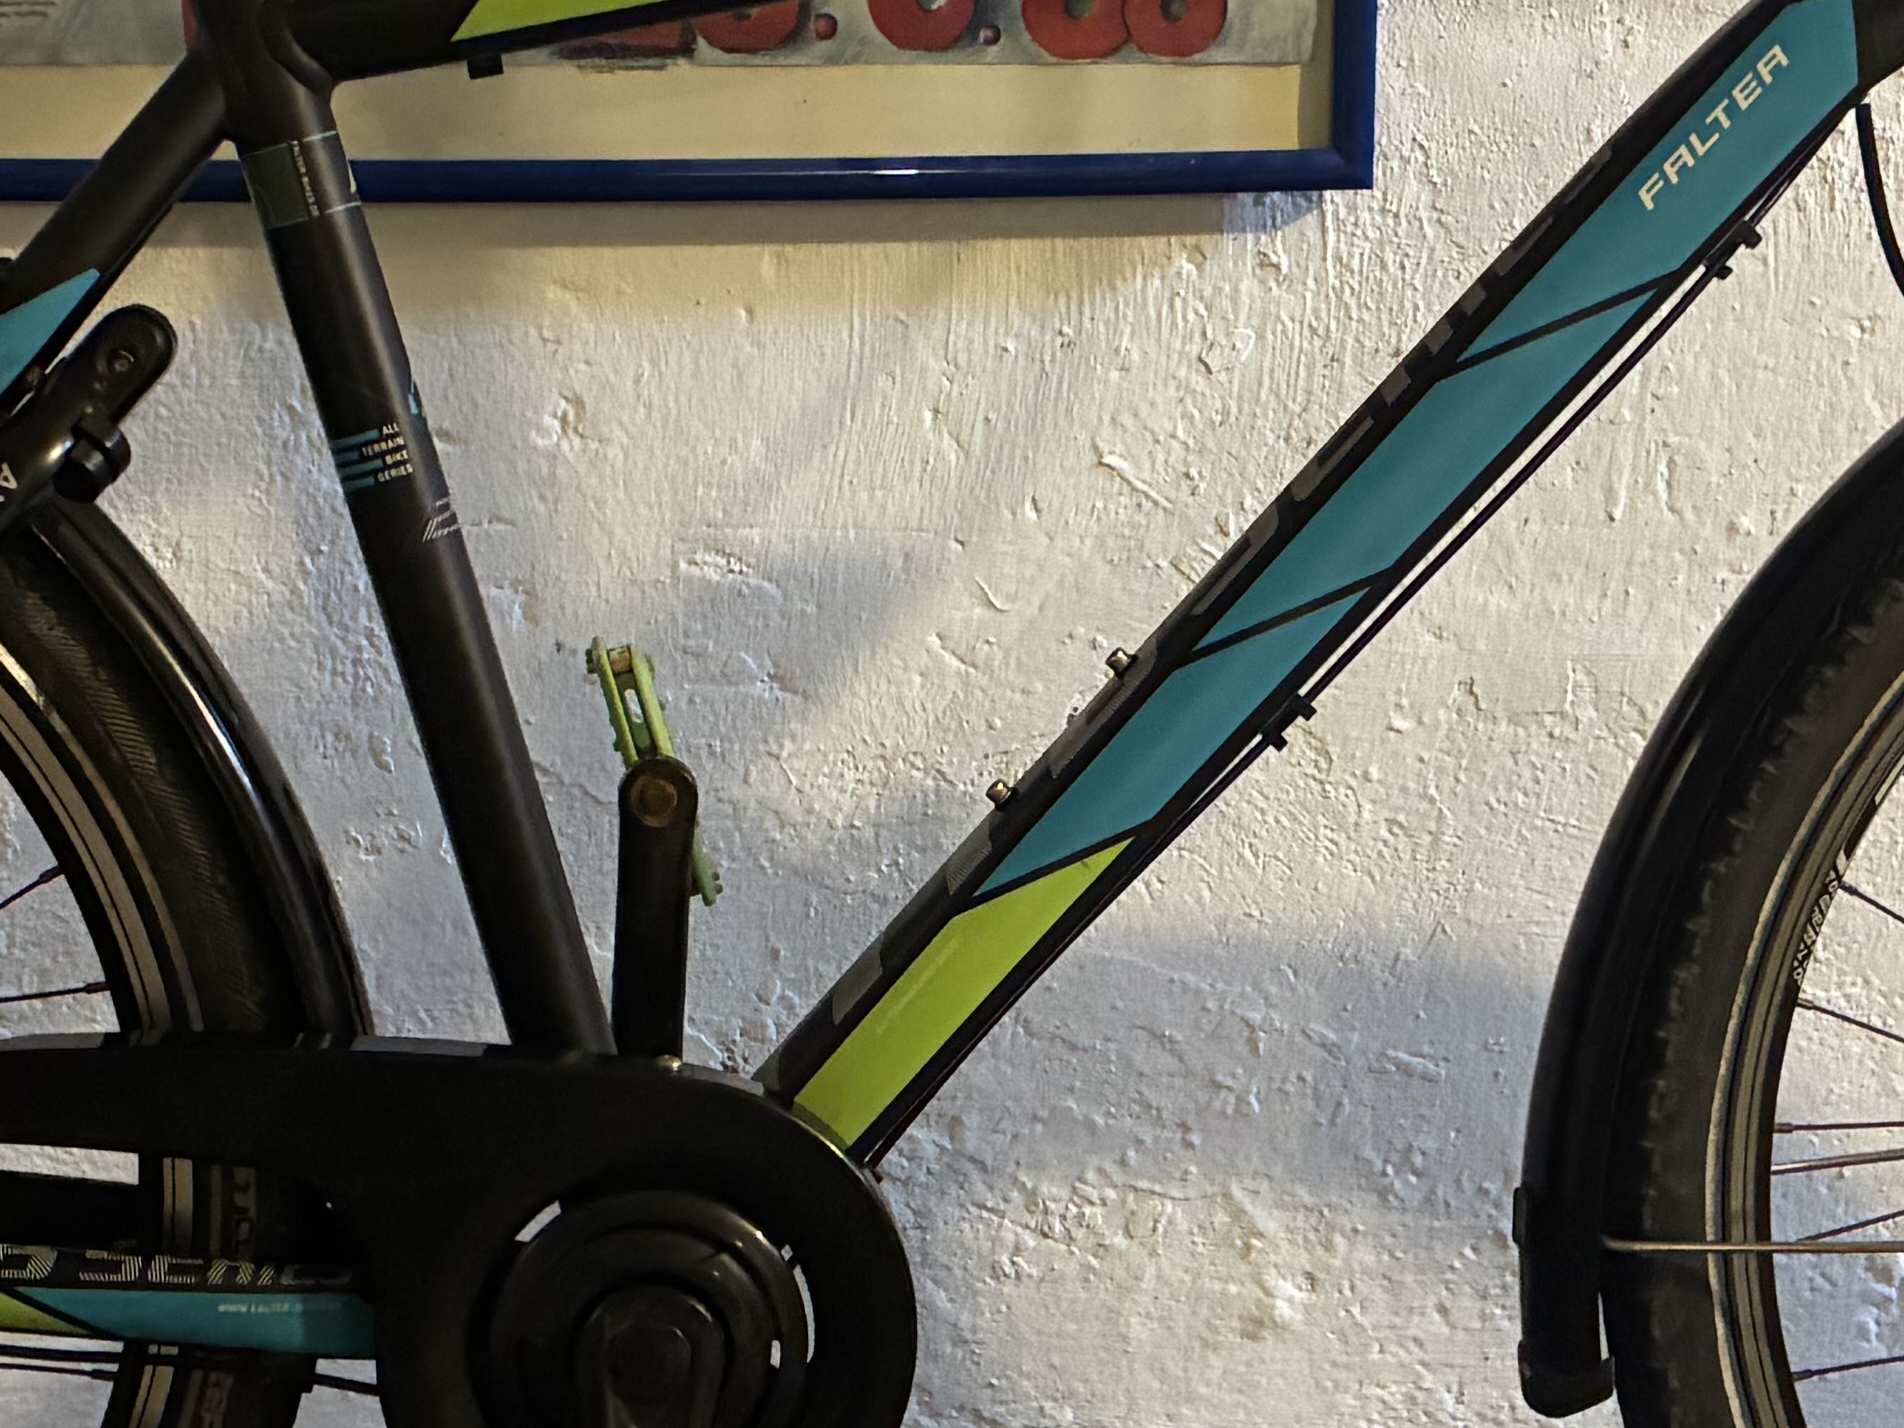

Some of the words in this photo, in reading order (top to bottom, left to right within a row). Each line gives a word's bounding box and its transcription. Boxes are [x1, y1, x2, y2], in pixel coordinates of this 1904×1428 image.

[1638, 44, 1790, 211] FALTER
[382, 422, 400, 436] ALL
[362, 436, 405, 457] TERRAIN
[385, 450, 409, 465] BIKE
[377, 463, 414, 482] SERIES
